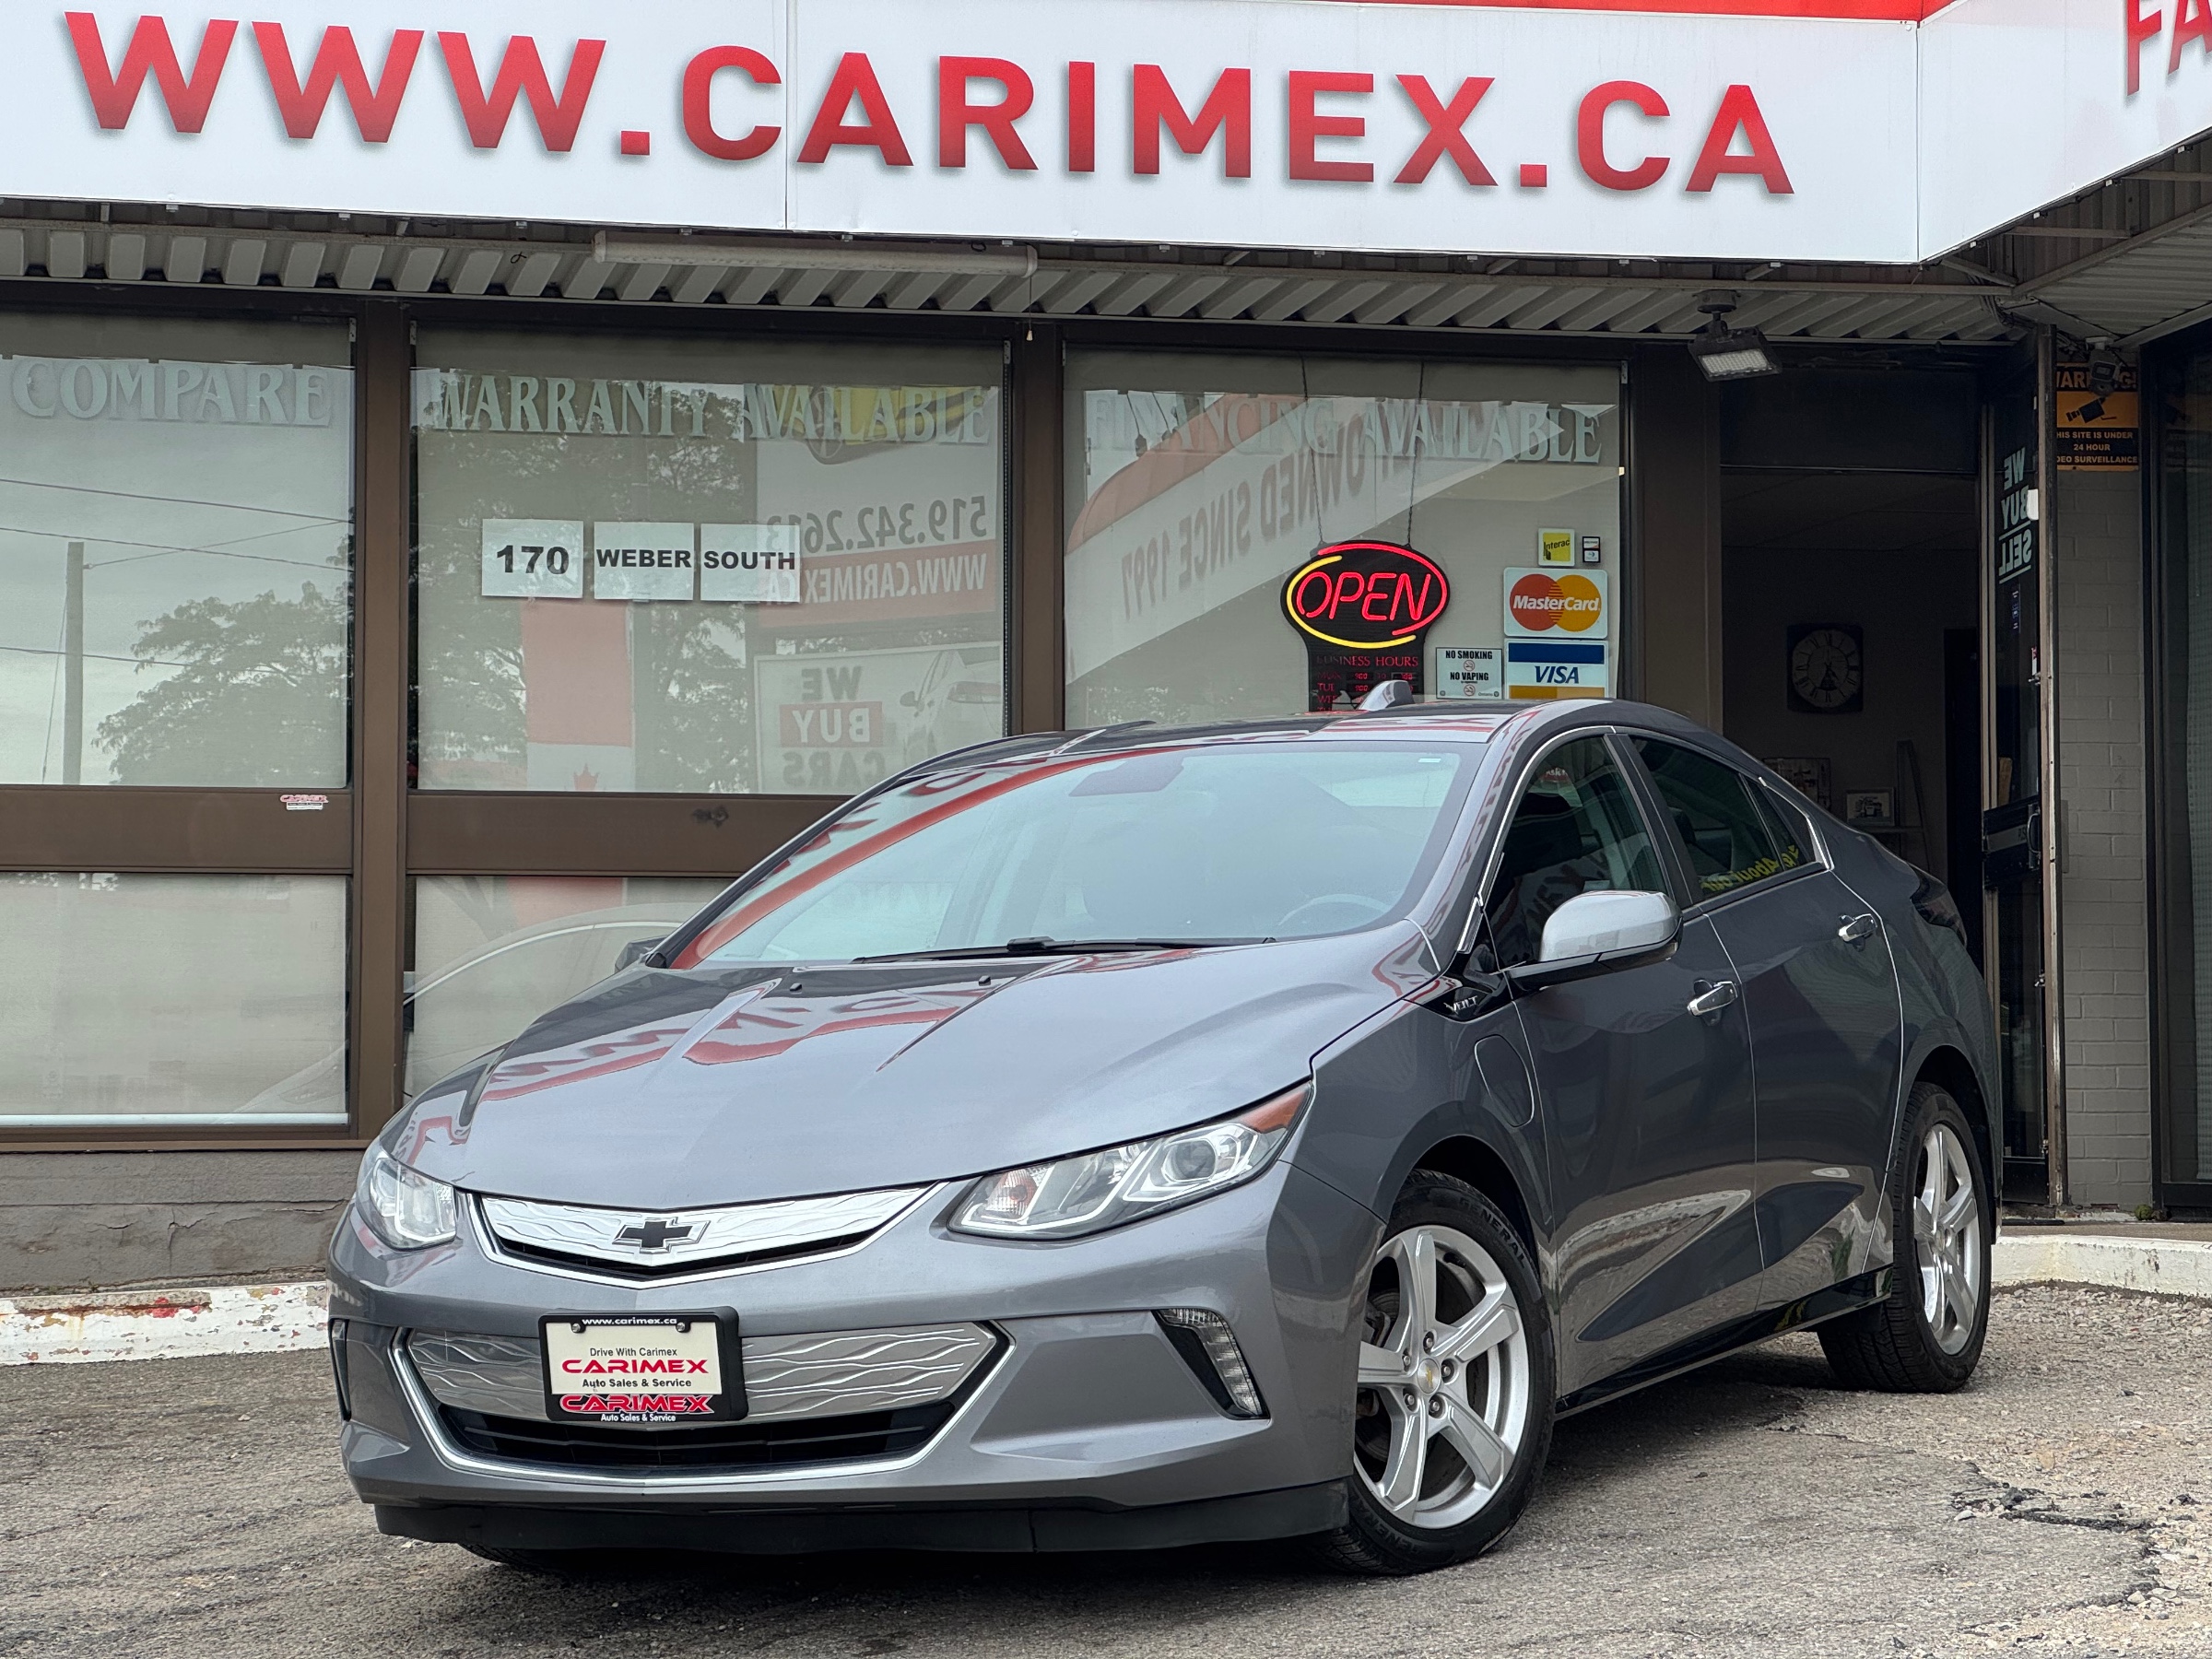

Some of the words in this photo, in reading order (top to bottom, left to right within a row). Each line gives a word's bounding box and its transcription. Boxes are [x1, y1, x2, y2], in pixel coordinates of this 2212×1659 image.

[65, 11, 1794, 195] WWW.CARIMEX.CA
[12, 359, 333, 427] COMPARE
[432, 372, 709, 437] WARRANTY
[730, 382, 992, 444] AVAILABLE
[1358, 398, 1602, 464] AVAILABLE
[1543, 538, 1571, 553] Interac
[496, 544, 570, 575] 170
[595, 548, 692, 569] WEBER
[702, 550, 796, 571] SOUTH
[1295, 571, 1432, 622] OPEN
[1512, 594, 1601, 612] MasterCard
[1316, 655, 1371, 666] BUSINESS
[1375, 656, 1418, 667] HOURS
[1445, 650, 1456, 659] NO
[1457, 650, 1493, 660] SMOKING
[1450, 671, 1461, 680] NO
[1461, 672, 1489, 681] VAPING
[1535, 665, 1580, 684] VISA
[582, 1317, 677, 1325] www.carimex.ca
[589, 1347, 615, 1357] Drive
[616, 1347, 637, 1357] With
[639, 1347, 678, 1357] Carimex
[561, 1359, 709, 1374] CARIMEX
[582, 1378, 606, 1388] Auto
[608, 1378, 639, 1388] Sales
[641, 1379, 650, 1387] &
[652, 1378, 692, 1388] Service
[559, 1394, 714, 1413] CARIMEX
[600, 1413, 618, 1422] Auto
[619, 1413, 641, 1422] Sales
[641, 1413, 648, 1422] &
[649, 1413, 677, 1422] Service
